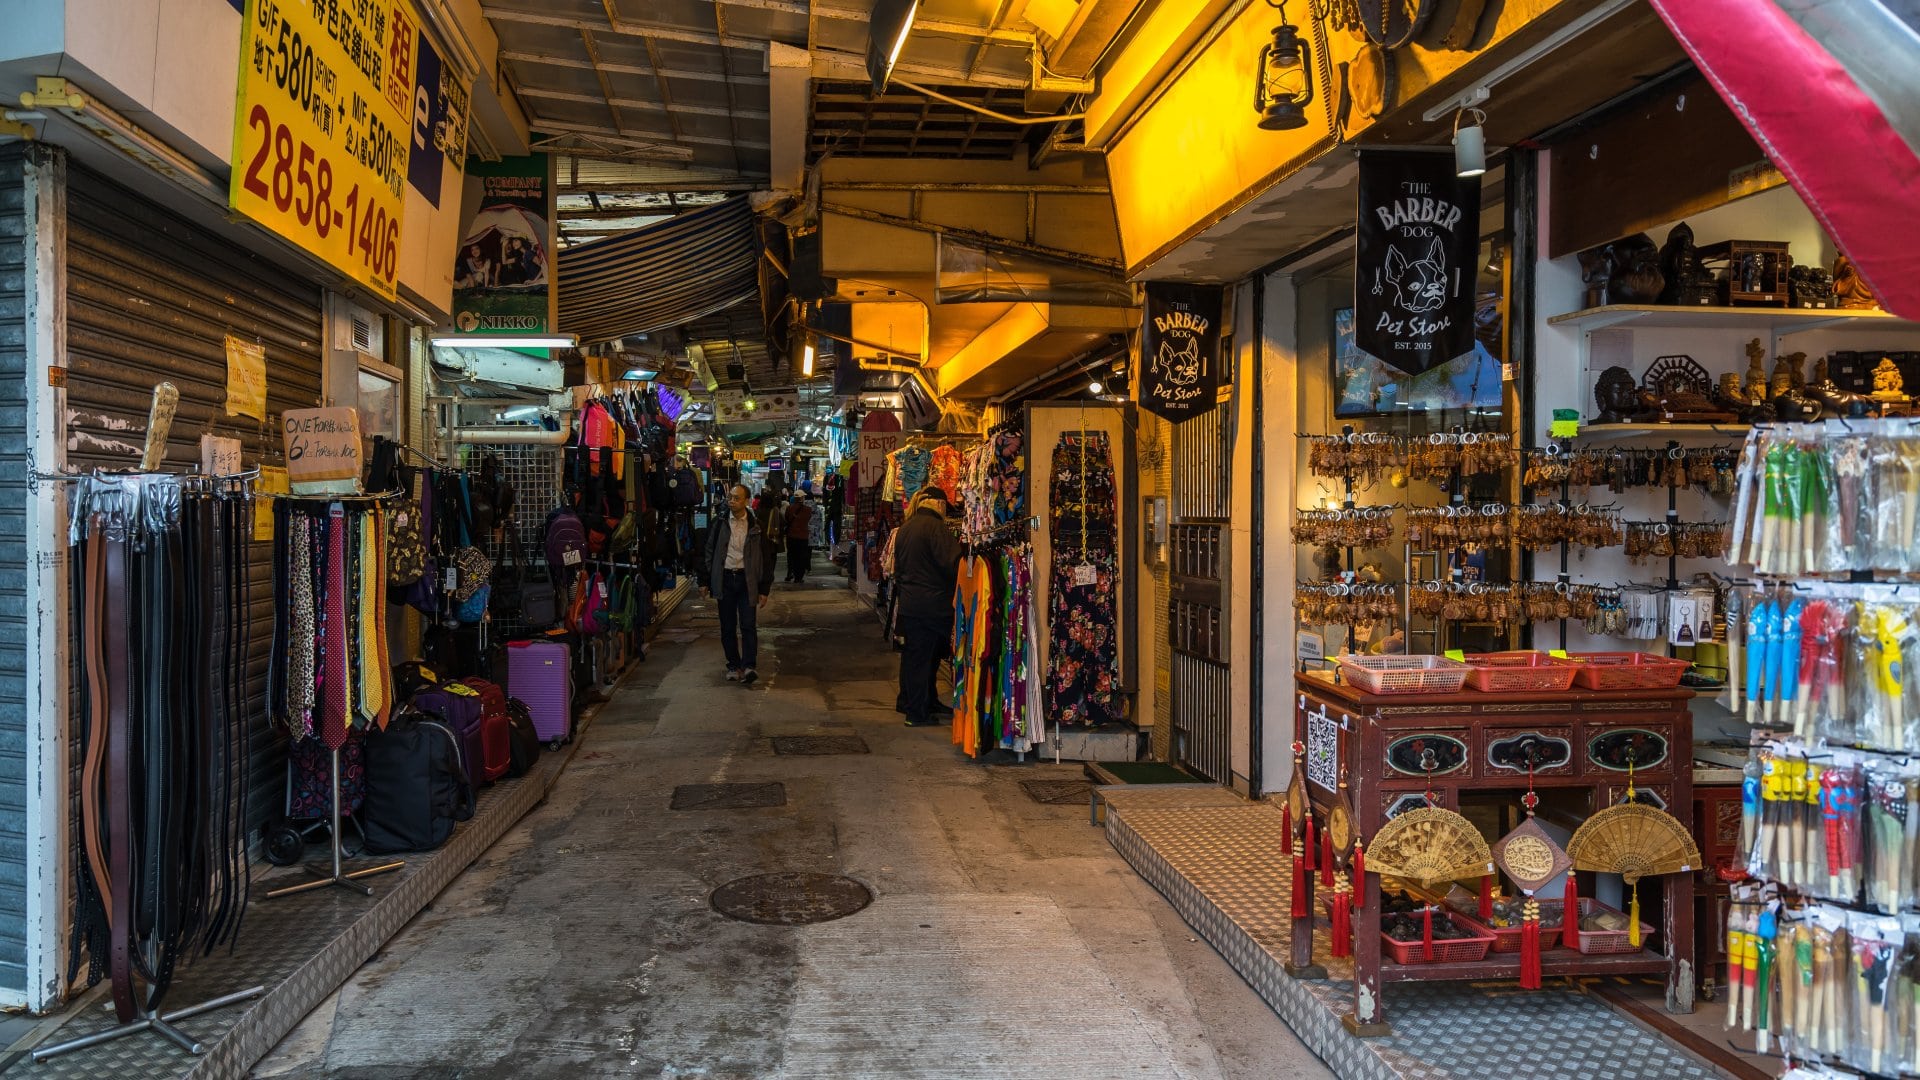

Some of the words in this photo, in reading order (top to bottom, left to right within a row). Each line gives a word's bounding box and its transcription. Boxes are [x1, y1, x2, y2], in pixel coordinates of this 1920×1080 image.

[390, 7, 411, 91] 租
[254, 34, 275, 82] 地下
[258, 0, 279, 36] G/F
[275, 18, 313, 111] 580
[368, 112, 393, 184] 580
[388, 75, 409, 115] RENT
[485, 177, 543, 189] COMPANY
[1400, 181, 1431, 194] THE
[244, 104, 398, 283] 2858-1406
[1376, 197, 1462, 233] BARBER
[1400, 225, 1433, 237] DOG
[1171, 302, 1191, 311] THE
[480, 315, 539, 330] NIKKO
[1154, 311, 1209, 335] BARBER
[1376, 311, 1403, 336] Pet
[1408, 315, 1451, 337] Store
[1170, 329, 1191, 338] DOG
[1394, 341, 1412, 350] EST.
[1414, 341, 1432, 350] 2015
[1153, 383, 1173, 400] Pet
[1174, 386, 1202, 400] Store
[286, 417, 312, 433] ONE
[1462, 565, 1480, 575] OPEN
